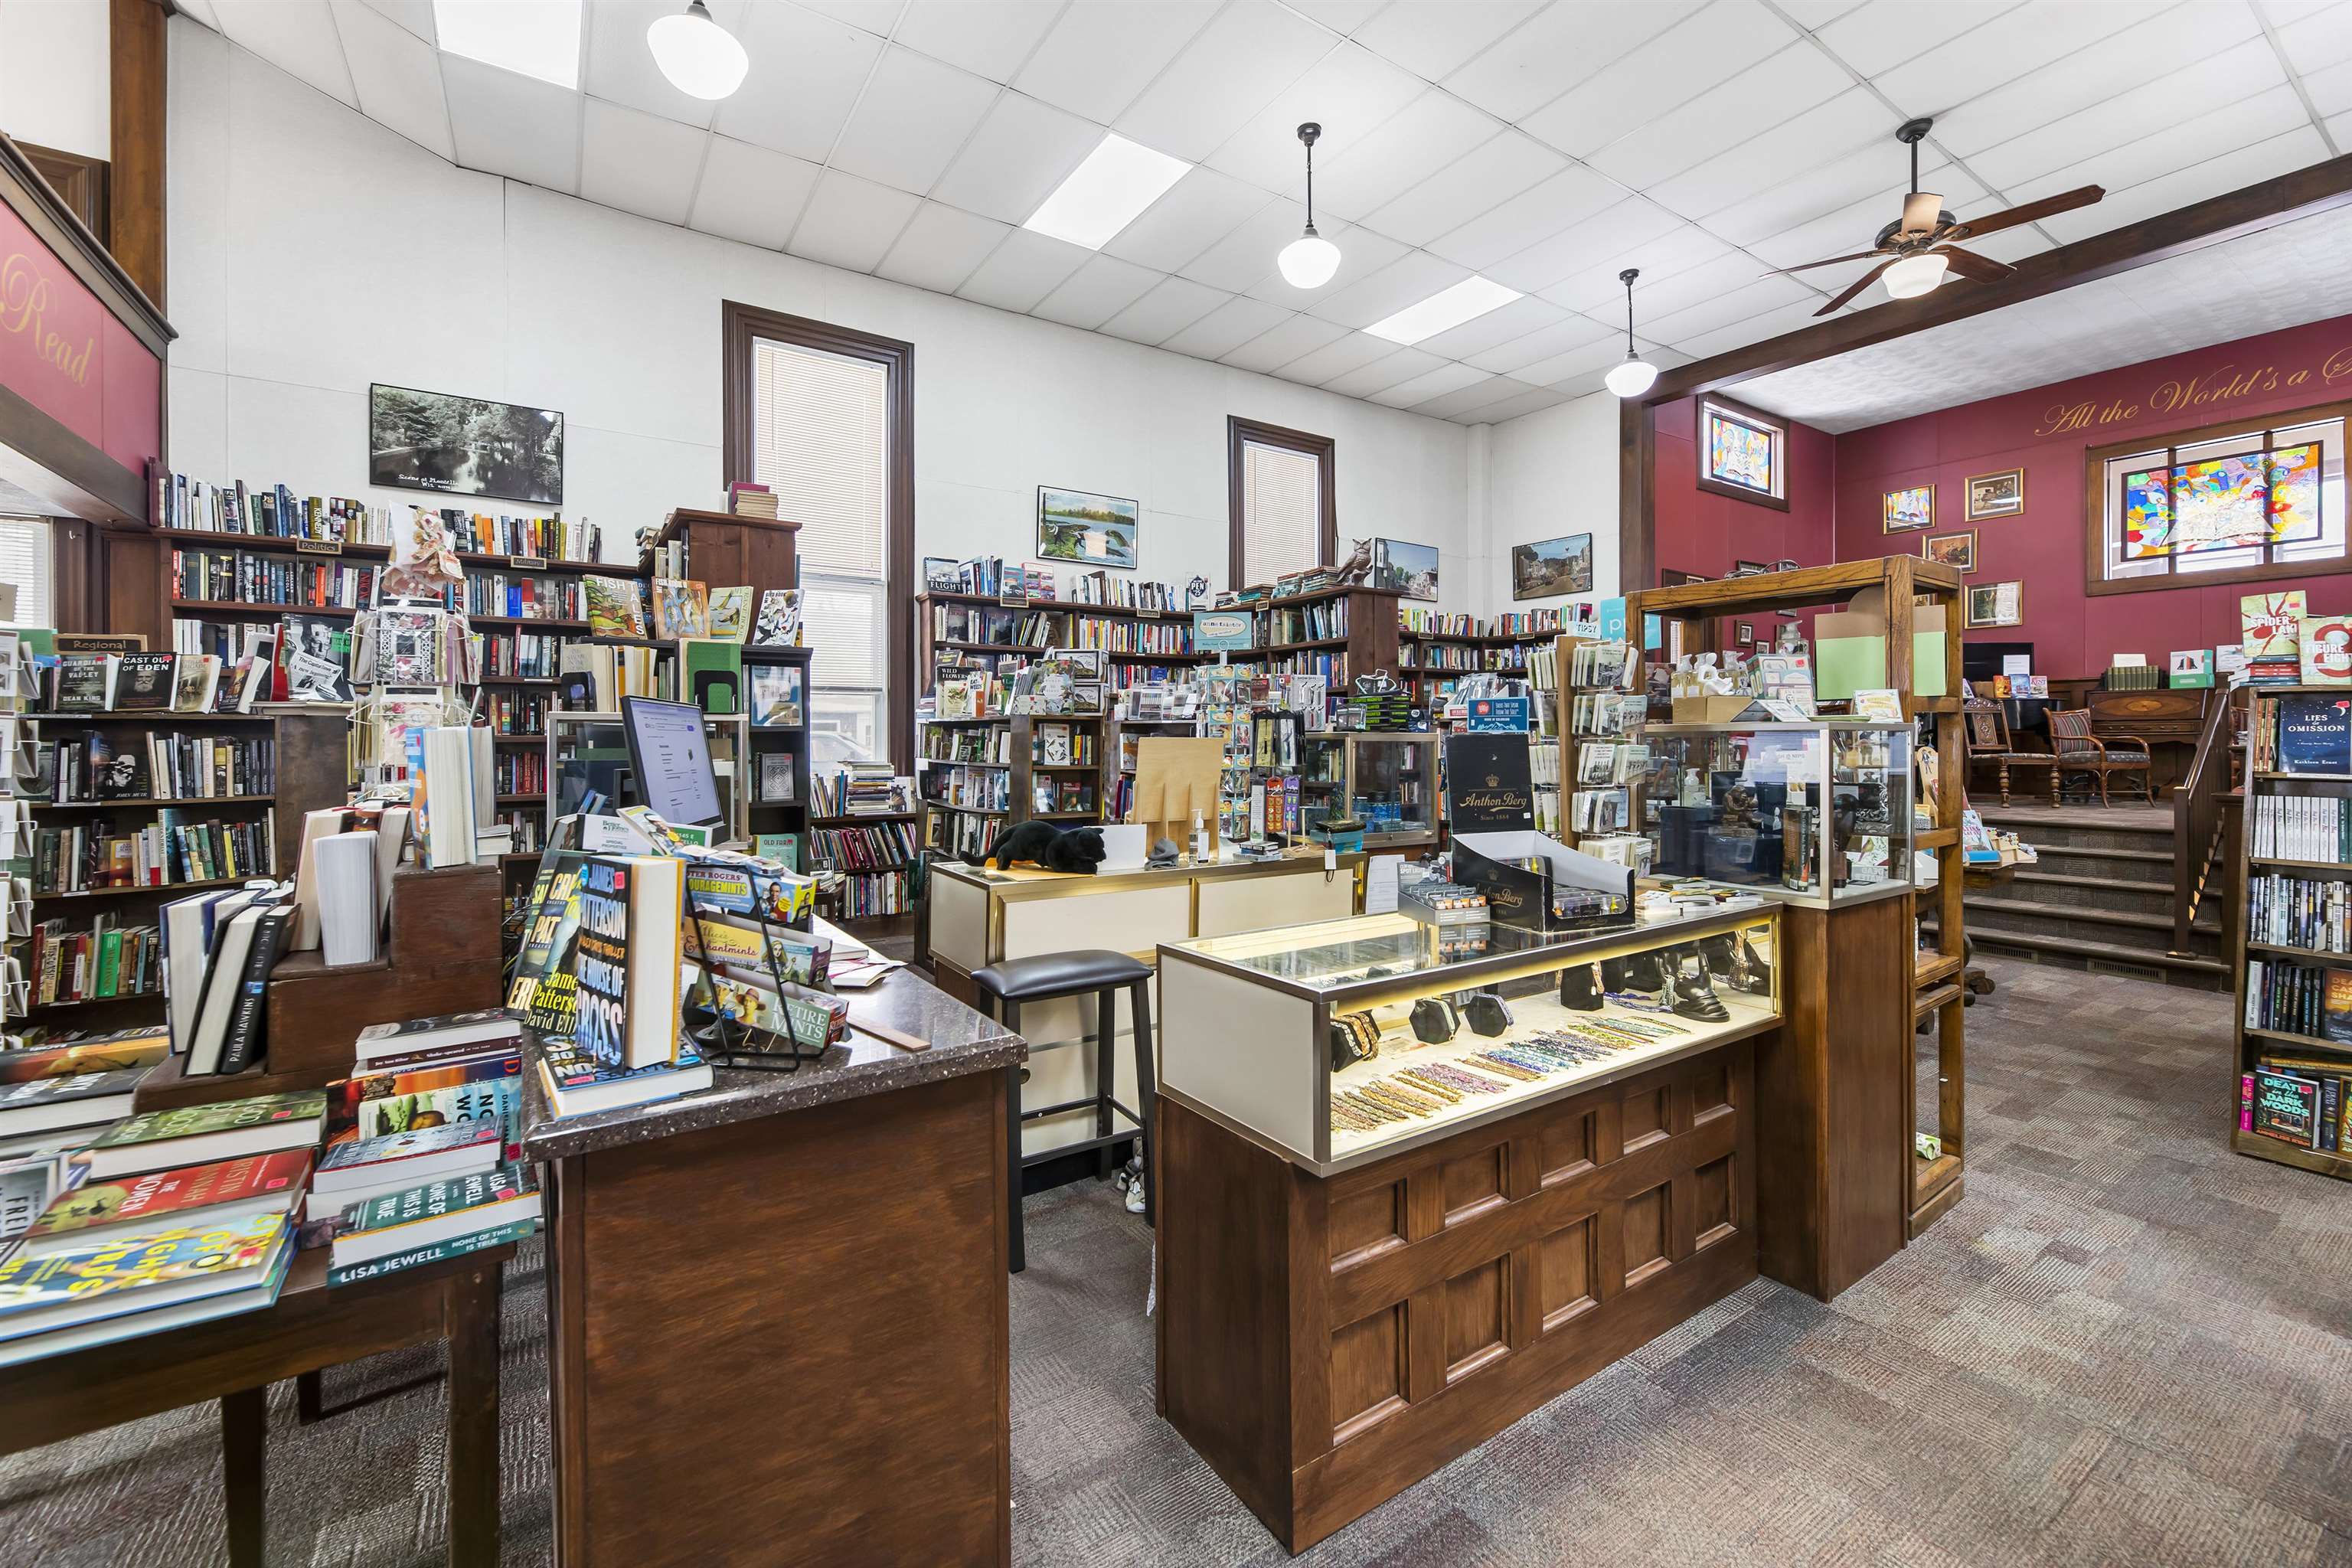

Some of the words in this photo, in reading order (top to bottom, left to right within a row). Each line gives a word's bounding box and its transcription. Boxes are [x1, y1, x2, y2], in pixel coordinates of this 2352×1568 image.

[0, 253, 95, 387] Read
[2034, 400, 2096, 436] All
[2099, 399, 2139, 424] the
[2150, 364, 2278, 413] World's
[2287, 369, 2311, 386] a
[314, 507, 323, 535] KENNEDY
[302, 541, 336, 552] Politics
[359, 573, 370, 600] NIXON
[596, 577, 626, 590] FISH
[930, 580, 962, 591] FLIGHT
[1191, 582, 1205, 591] PEN
[2250, 615, 2290, 628] SPIDER
[74, 640, 126, 650] Regional
[2324, 652, 2350, 663] EIGH
[2030, 677, 2046, 686] KENT
[1459, 792, 1501, 807] Anthon
[1501, 792, 1527, 810] Berg
[689, 877, 748, 896] OURAGEMINTS
[684, 935, 760, 957] Enhantmints
[545, 969, 579, 990] Jame
[612, 965, 626, 997] OF
[230, 1035, 245, 1063] PAULA
[238, 997, 255, 1032] HAWKINS
[524, 1011, 555, 1030] David
[2263, 1077, 2300, 1091] DEAT
[2260, 1097, 2310, 1117] WOODS
[2265, 1092, 2304, 1109] DARK
[180, 1166, 222, 1204] ANNAH
[217, 1161, 253, 1195] RISTIN
[5, 1195, 30, 1232] FREI
[377, 1196, 397, 1220] TRUE
[452, 1236, 478, 1249] NONE
[479, 1234, 492, 1243] OF
[492, 1227, 513, 1239] THIS
[476, 1238, 500, 1250] TRUE
[339, 1265, 379, 1283] LISA
[381, 1247, 445, 1273] JEWELL
